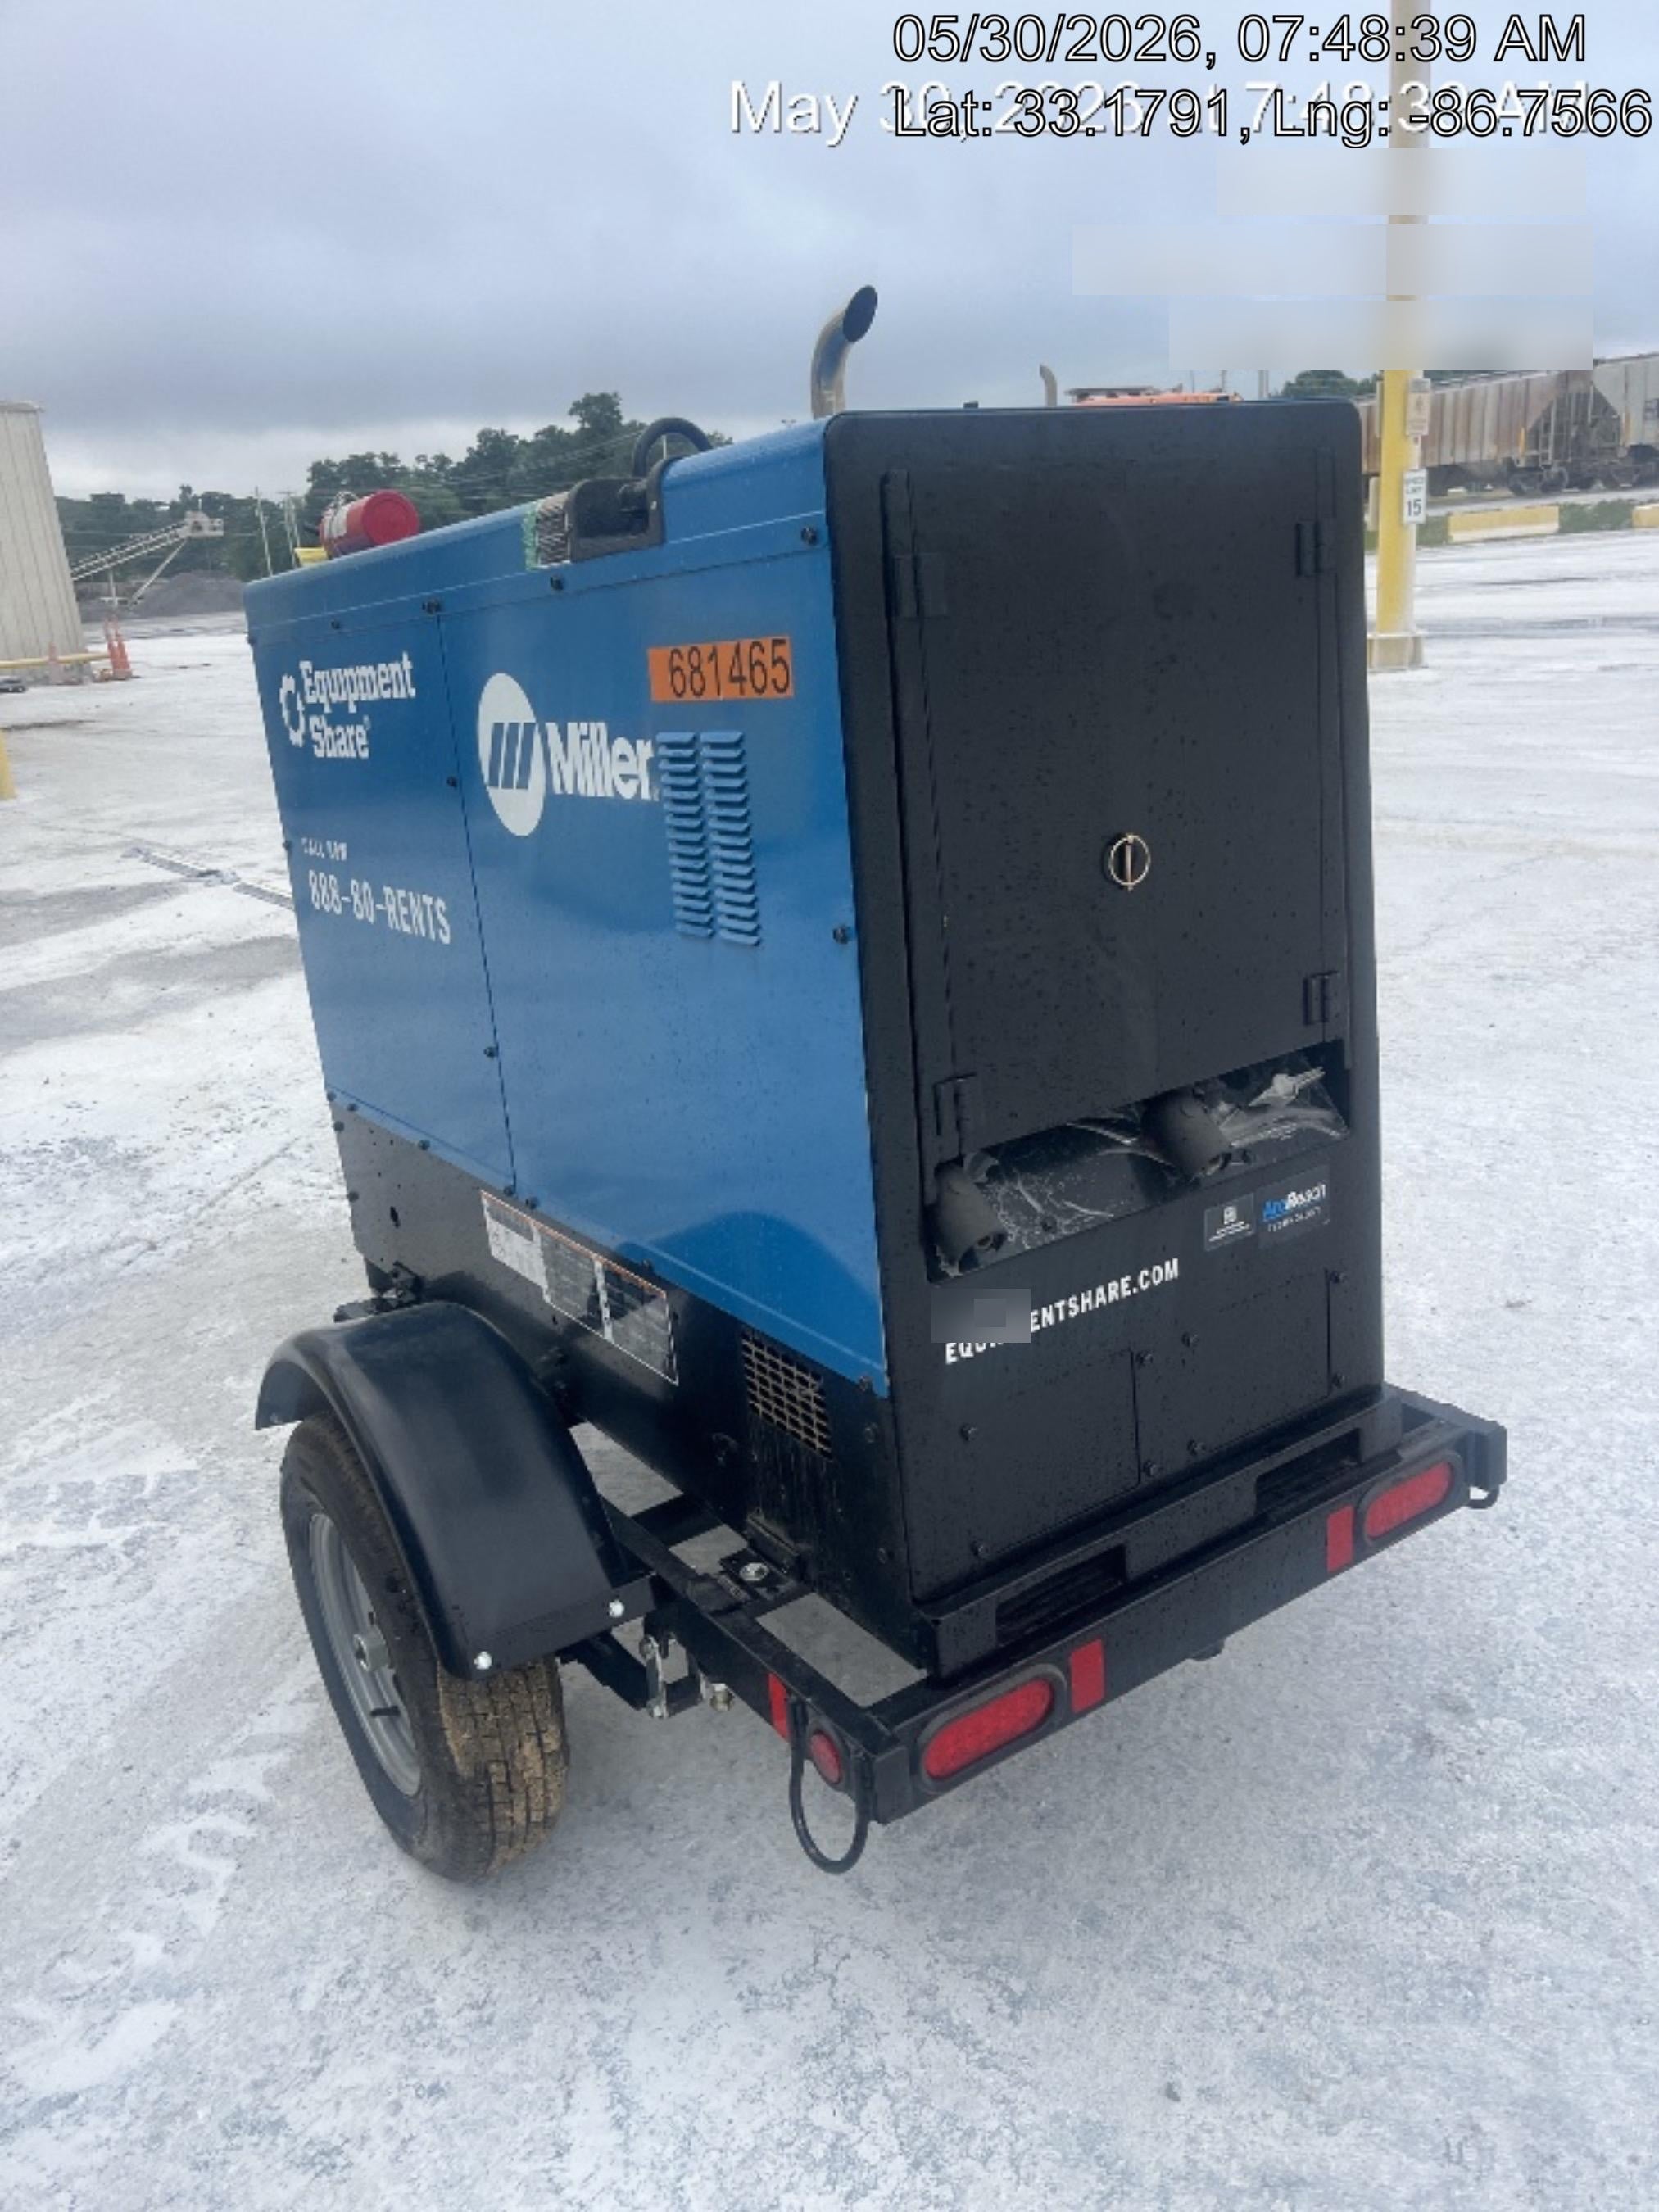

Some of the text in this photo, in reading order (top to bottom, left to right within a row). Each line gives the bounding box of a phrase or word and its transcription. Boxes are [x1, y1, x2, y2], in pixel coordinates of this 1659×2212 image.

[1407, 498, 1422, 517] 15
[299, 651, 415, 714] Equipment
[668, 638, 790, 698] 681465
[545, 721, 655, 801] Miller
[309, 869, 451, 945] 888-80-RENTS
[945, 1258, 1180, 1365] EQENTSHARE.COM
